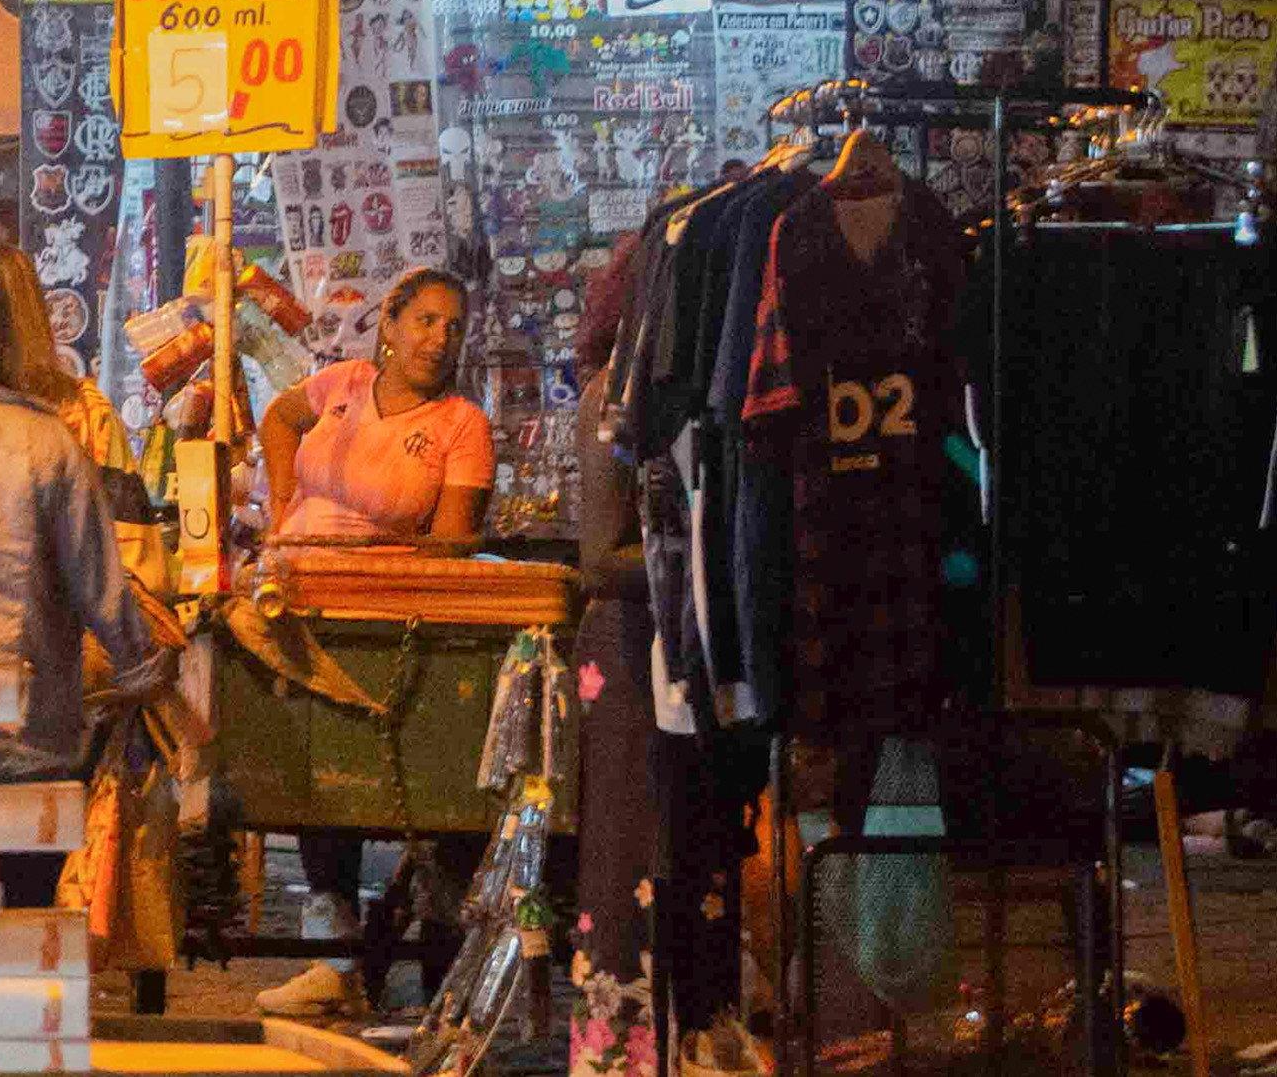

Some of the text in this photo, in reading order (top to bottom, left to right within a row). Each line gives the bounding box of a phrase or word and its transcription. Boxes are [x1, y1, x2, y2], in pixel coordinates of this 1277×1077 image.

[159, 1, 221, 30] 600
[593, 82, 694, 111] Red Bull
